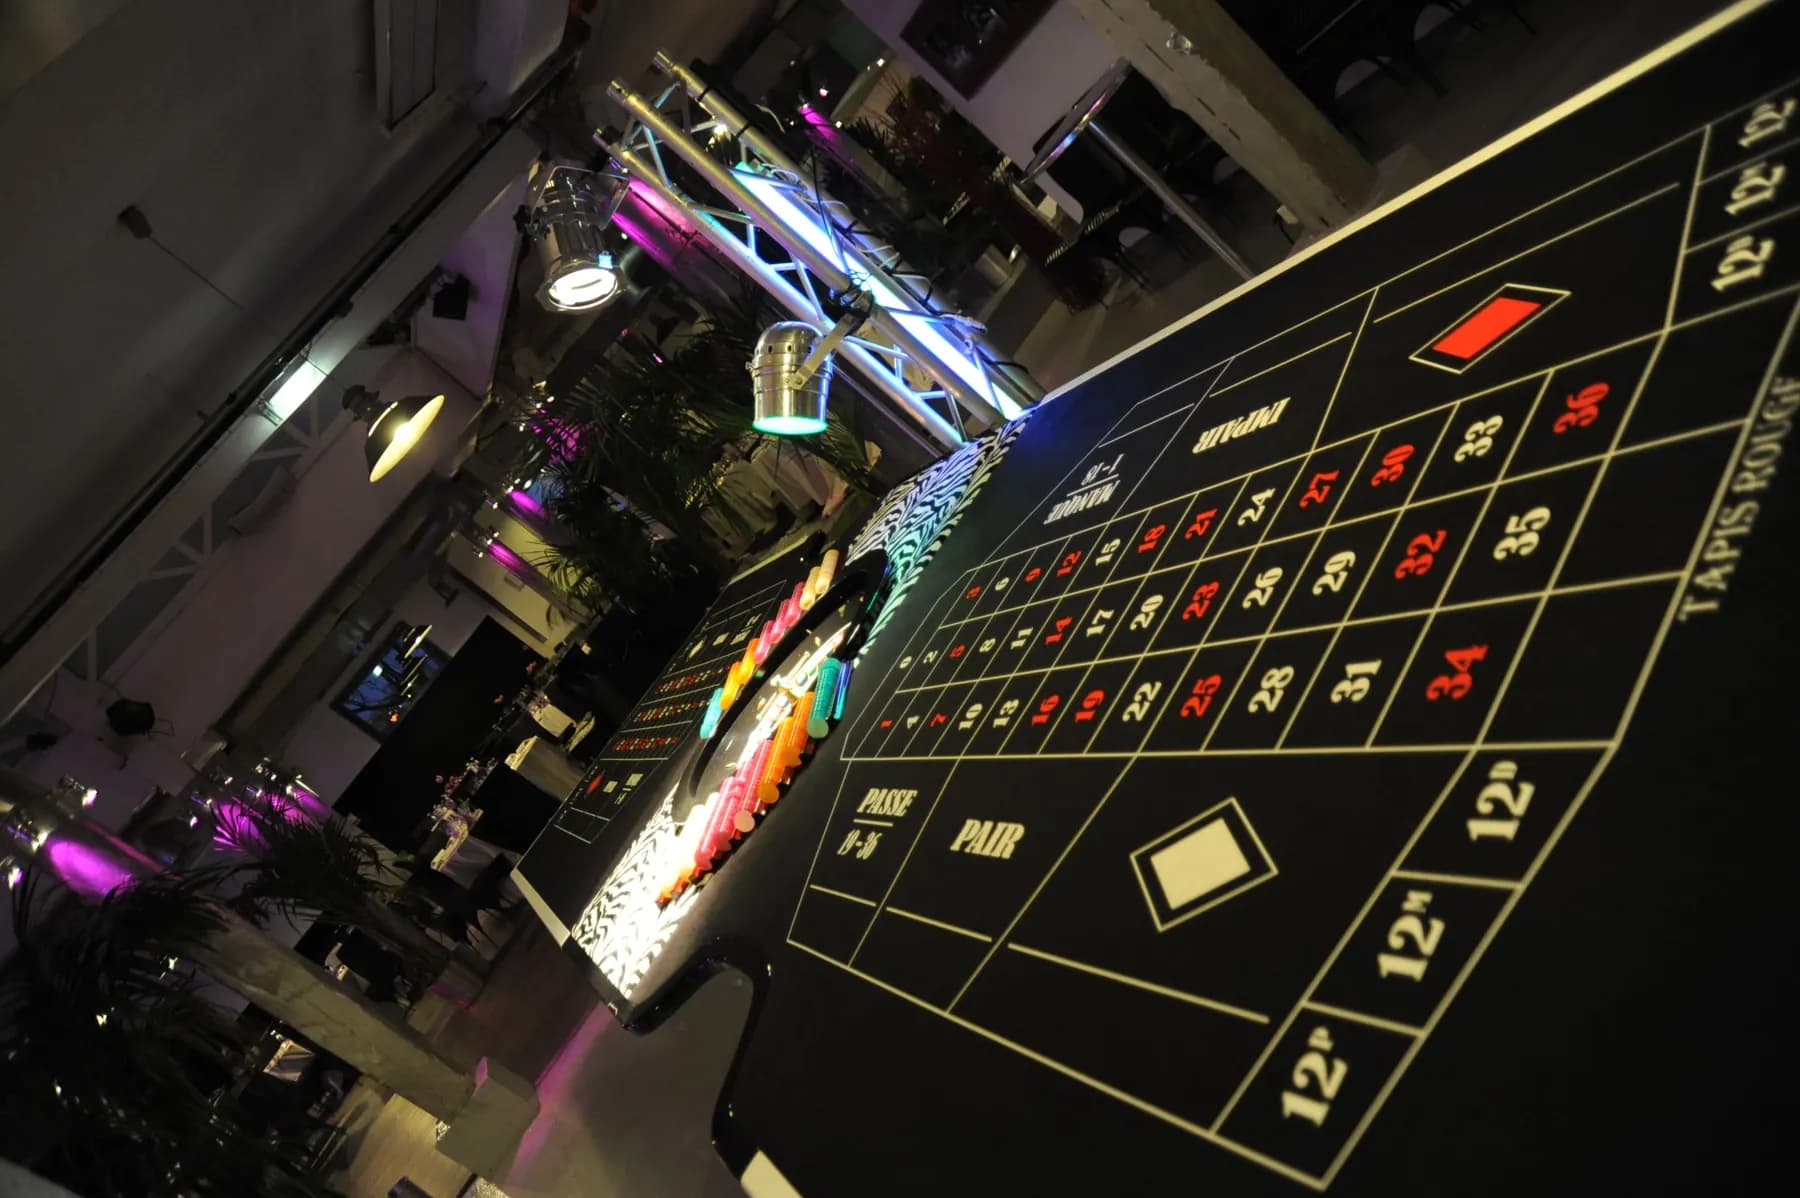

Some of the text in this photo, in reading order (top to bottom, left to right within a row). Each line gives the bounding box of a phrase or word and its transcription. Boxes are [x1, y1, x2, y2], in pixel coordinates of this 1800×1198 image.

[1191, 396, 1291, 454] IMPAIR
[1554, 383, 1609, 433] 36
[1454, 416, 1503, 462] 33
[1371, 444, 1414, 486] 30
[1043, 480, 1121, 525] MANQUE
[1238, 488, 1275, 525] 24
[1300, 471, 1338, 507] 27
[1139, 525, 1165, 552] 18
[1185, 509, 1216, 539] 21
[1494, 507, 1550, 560] 35
[1056, 550, 1083, 577] 12
[1096, 539, 1120, 565] 15
[1395, 530, 1446, 579] 32
[1678, 501, 1758, 621] TAPIS
[1243, 568, 1282, 608] 26
[1313, 551, 1355, 595] 29
[1130, 595, 1163, 630] 20
[1183, 582, 1219, 620] 23
[1010, 627, 1034, 650] 11
[1046, 617, 1072, 644] 14
[1087, 610, 1114, 637] 17
[923, 650, 938, 664] 2
[979, 638, 996, 653] 8
[1248, 666, 1294, 712] 28
[1331, 660, 1381, 703] 31
[1426, 646, 1487, 700] 34
[993, 699, 1020, 729] 13
[1031, 695, 1060, 726] 16
[1074, 689, 1105, 724] 19
[1123, 682, 1161, 721] 22
[1180, 674, 1222, 718] 25
[930, 713, 947, 727] 7
[958, 703, 983, 731] 10
[857, 788, 917, 816] PASSE
[950, 819, 1024, 859] PAIR
